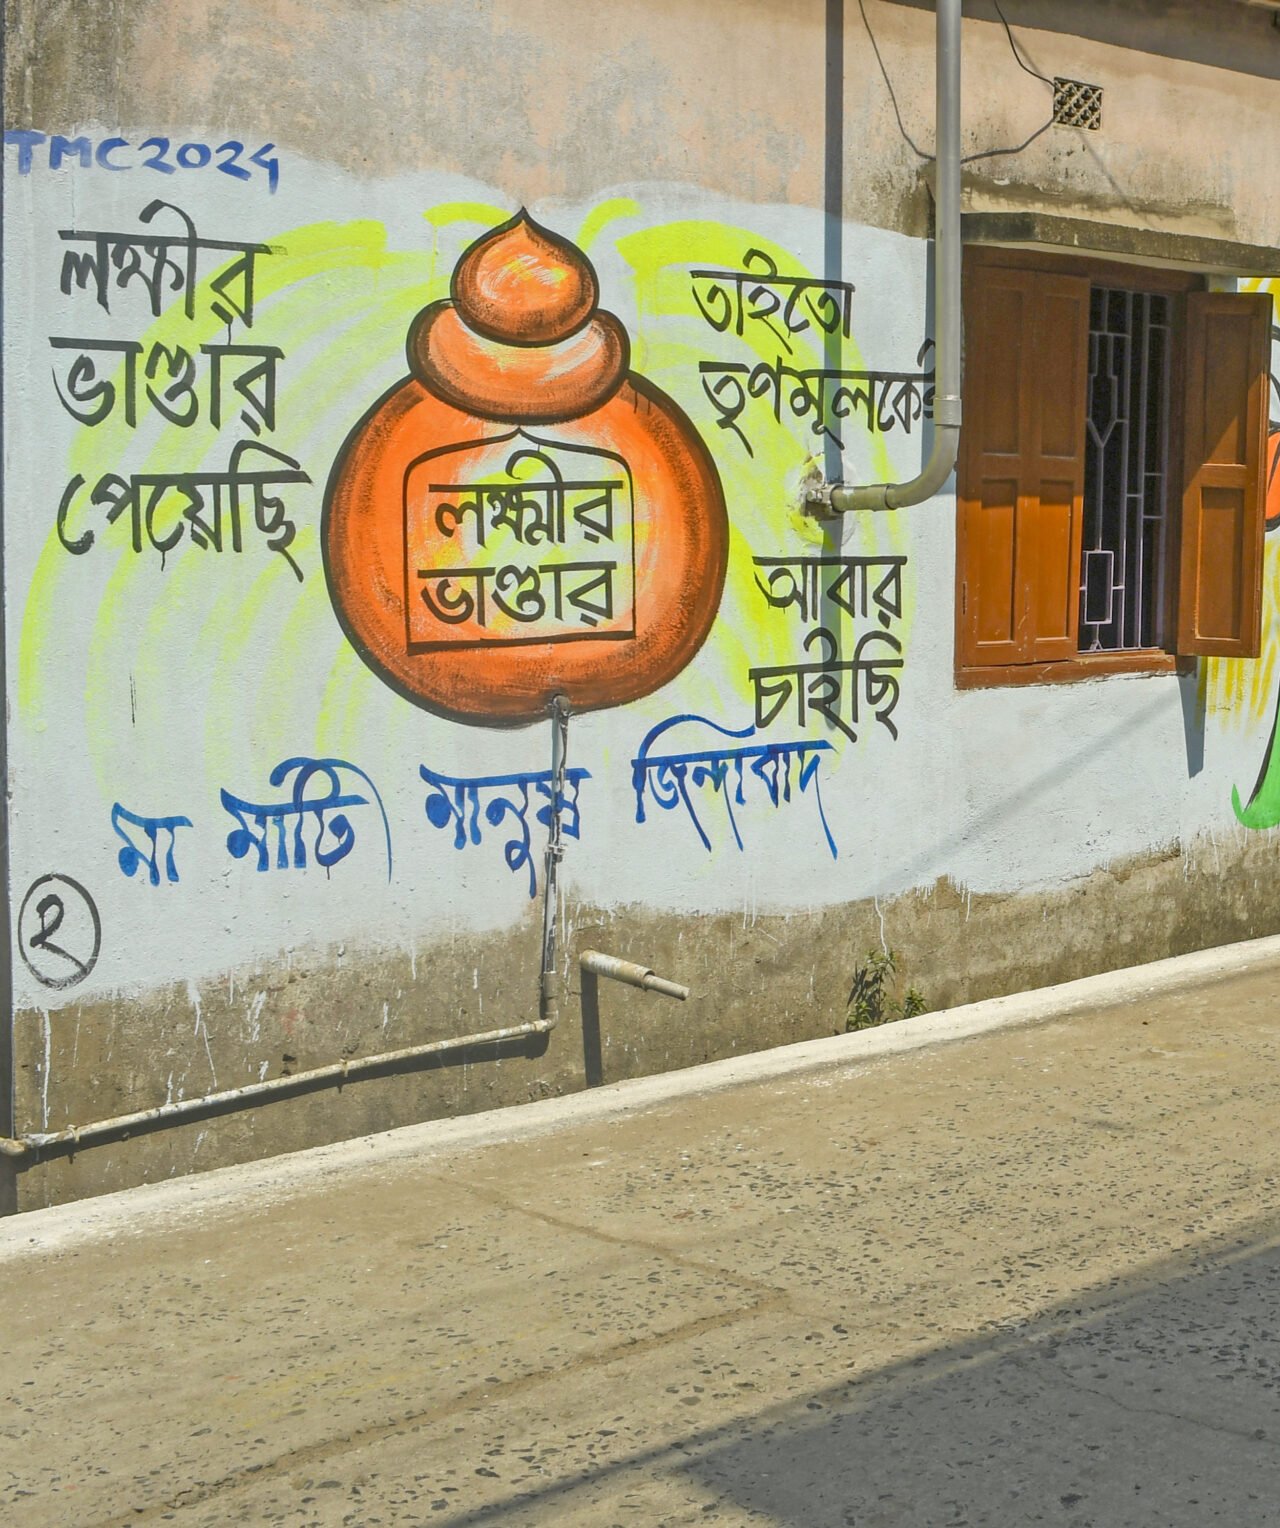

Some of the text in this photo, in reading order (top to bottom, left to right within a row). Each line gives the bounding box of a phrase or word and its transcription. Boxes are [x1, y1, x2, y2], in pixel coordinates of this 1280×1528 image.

[690, 248, 856, 355] তাইতো
[49, 335, 286, 436] ভাণ্ডার
[417, 560, 618, 628] ভাণ্ডার
[752, 556, 907, 629] আবার
[749, 626, 905, 743] চাইছি
[111, 715, 838, 899] মা মাটি মানুষ জিন্দাবাদ
